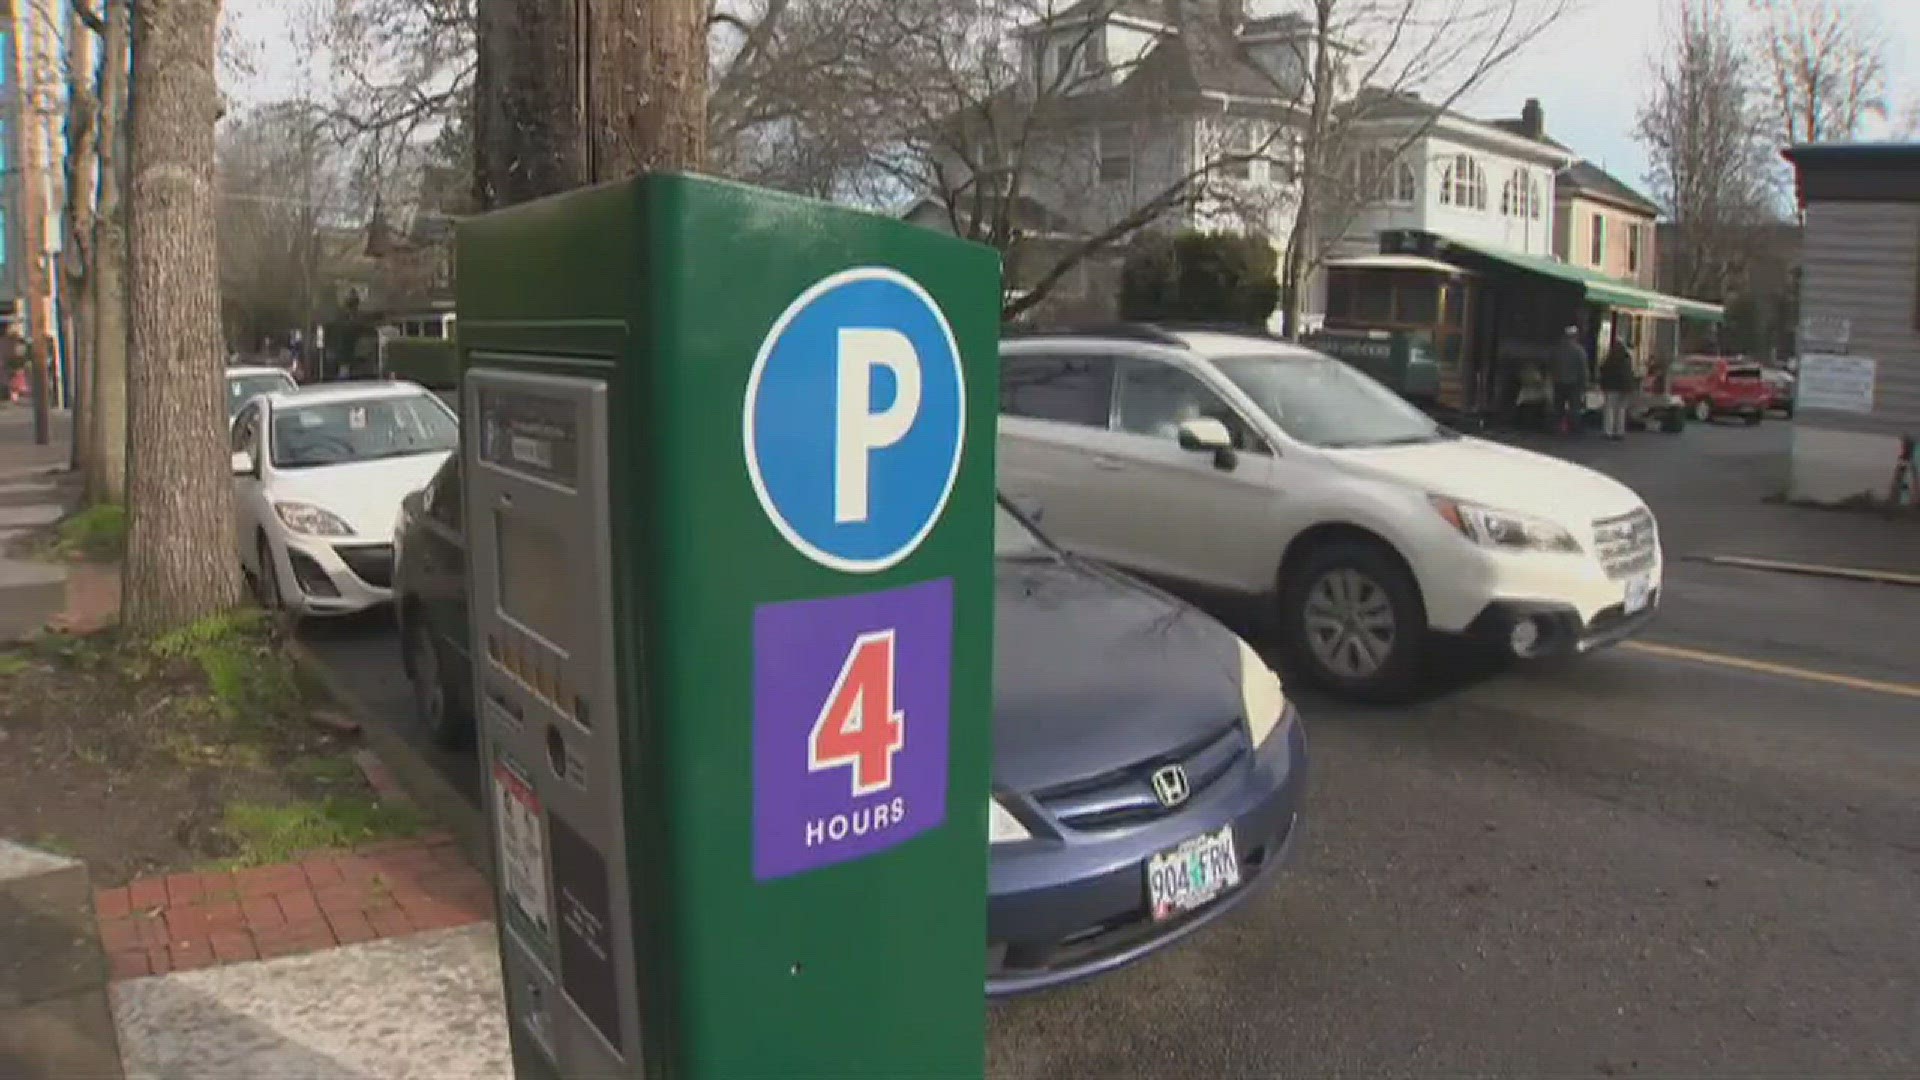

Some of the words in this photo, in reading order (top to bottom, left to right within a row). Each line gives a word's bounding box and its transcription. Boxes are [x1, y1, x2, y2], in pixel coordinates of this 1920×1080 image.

[835, 327, 922, 524] P
[808, 627, 905, 797] 4
[806, 796, 905, 847] HOURS
